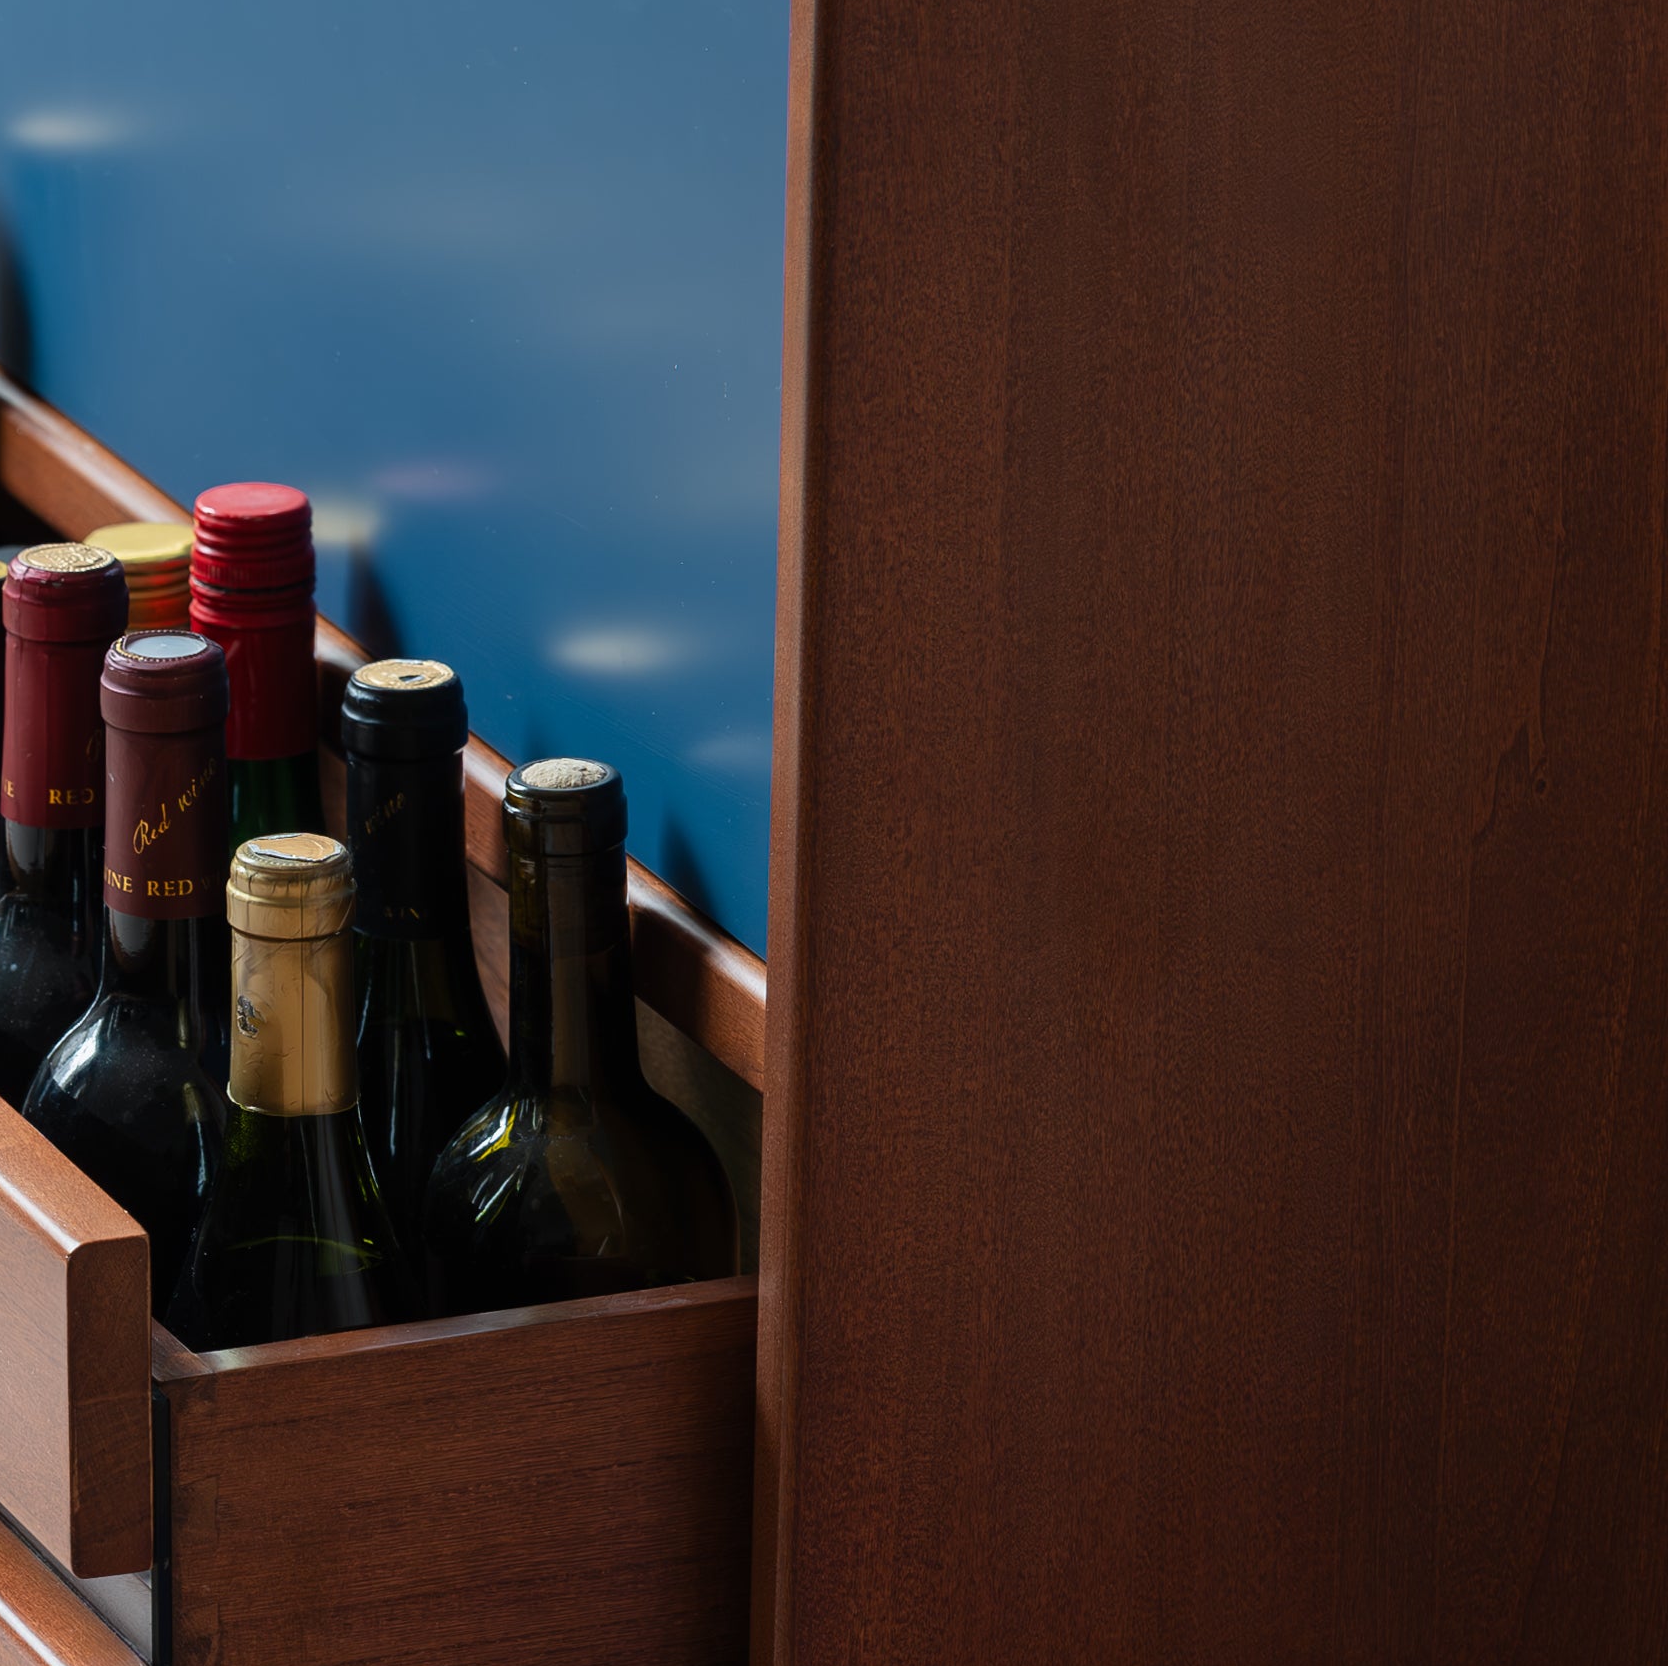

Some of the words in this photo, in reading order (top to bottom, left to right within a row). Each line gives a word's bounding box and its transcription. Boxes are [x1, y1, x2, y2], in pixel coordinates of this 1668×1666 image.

[48, 789, 95, 805] RED
[133, 803, 171, 854] Red
[178, 757, 217, 812] wine
[105, 868, 133, 893] INE
[147, 879, 194, 897] RED
